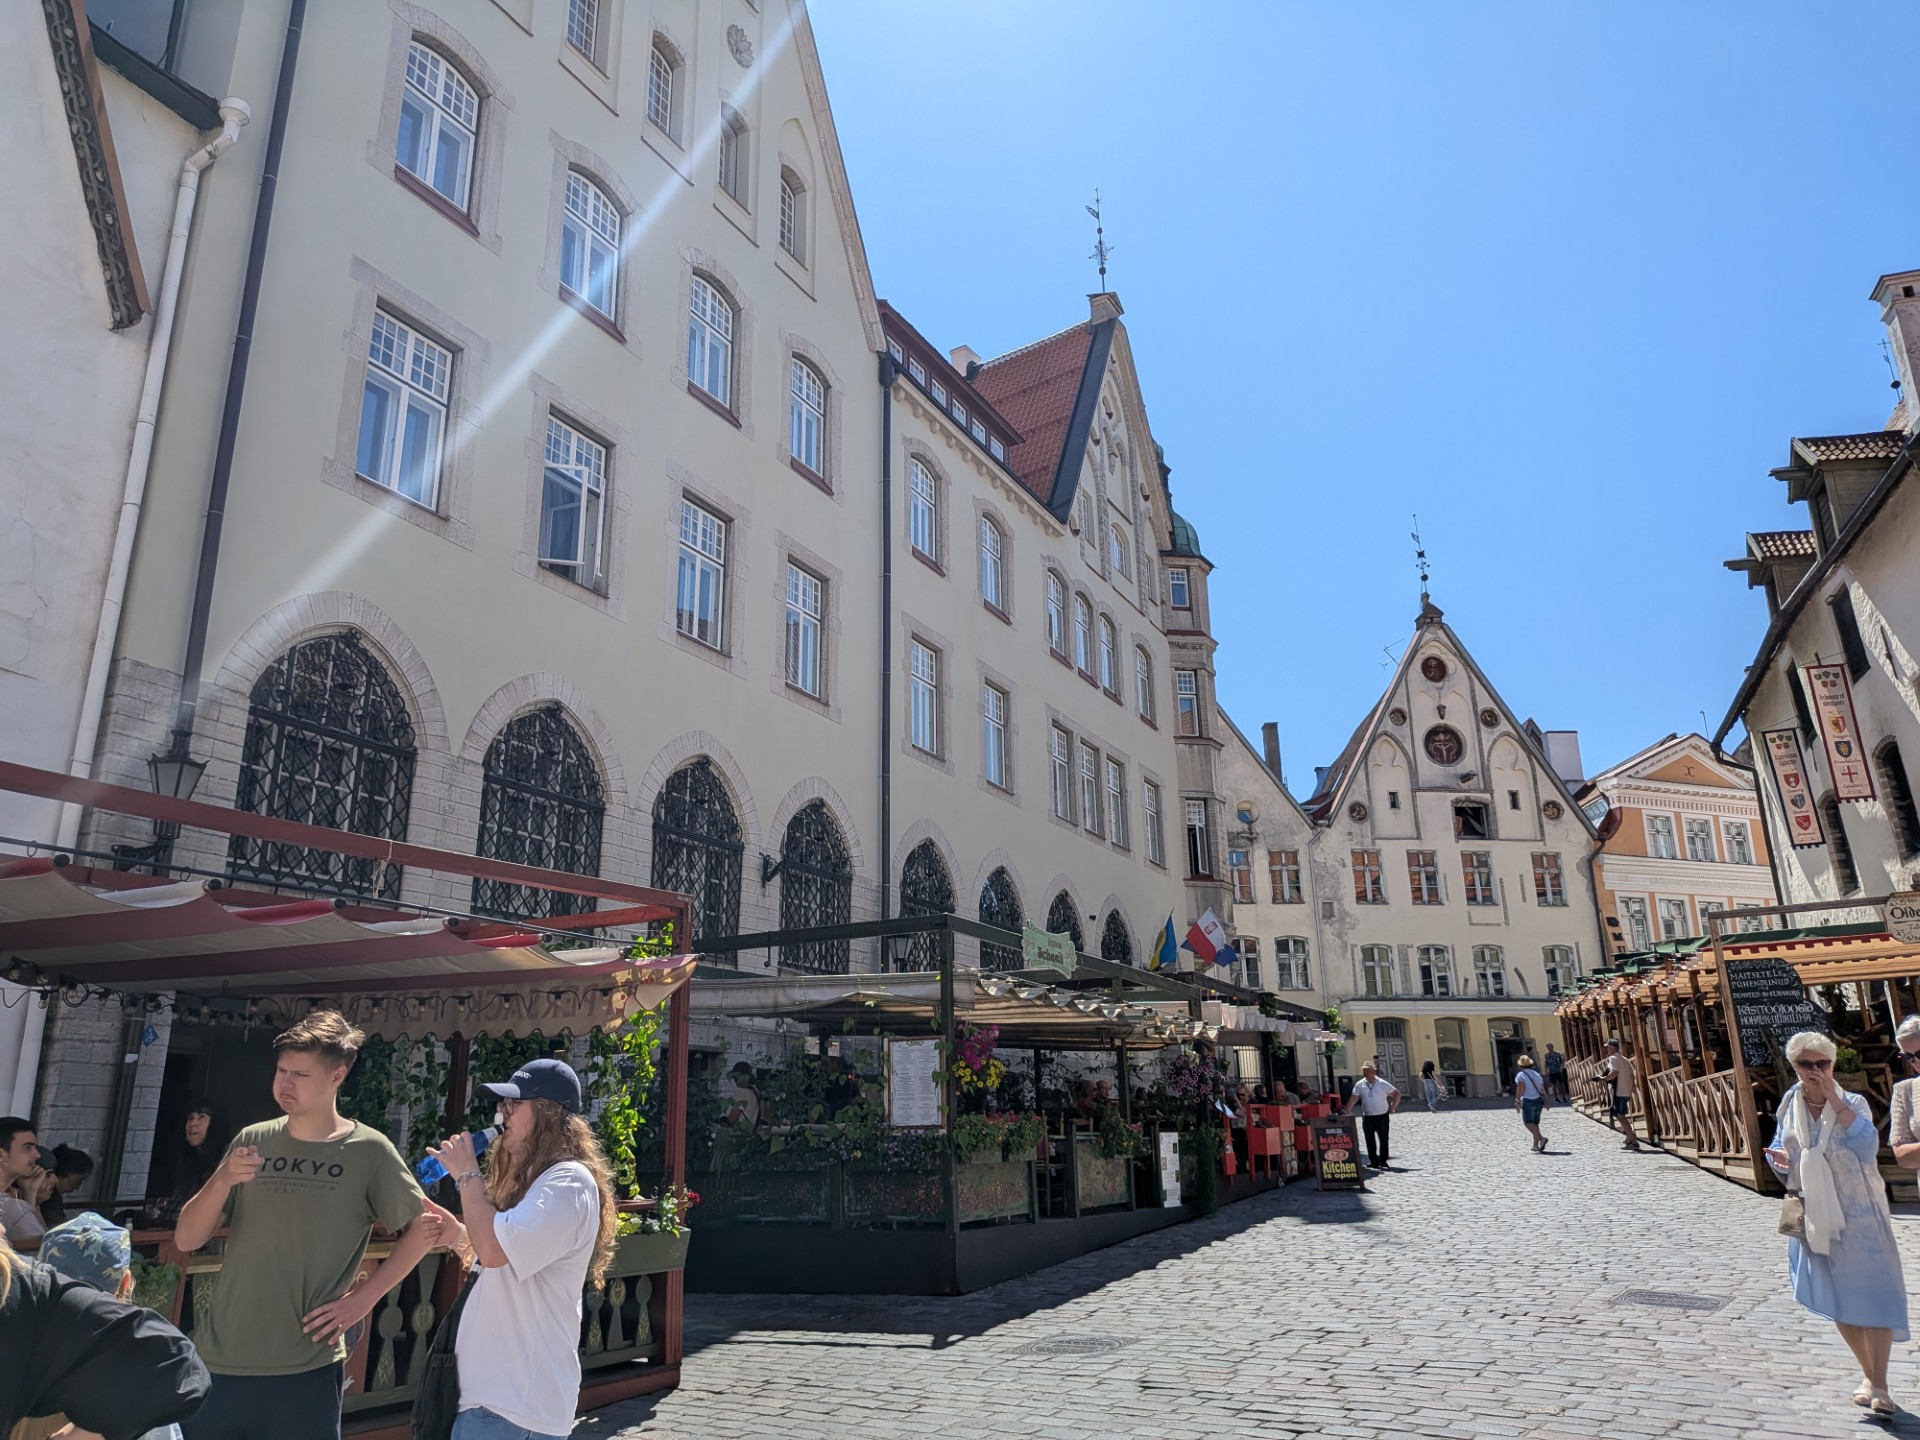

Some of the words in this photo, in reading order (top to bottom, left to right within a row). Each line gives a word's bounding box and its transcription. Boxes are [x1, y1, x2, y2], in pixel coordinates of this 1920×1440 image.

[1890, 906, 1920, 920] Olde
[261, 1156, 344, 1178] TOKYO
[1322, 1160, 1357, 1174] Kitchen
[1334, 1172, 1358, 1180] open
